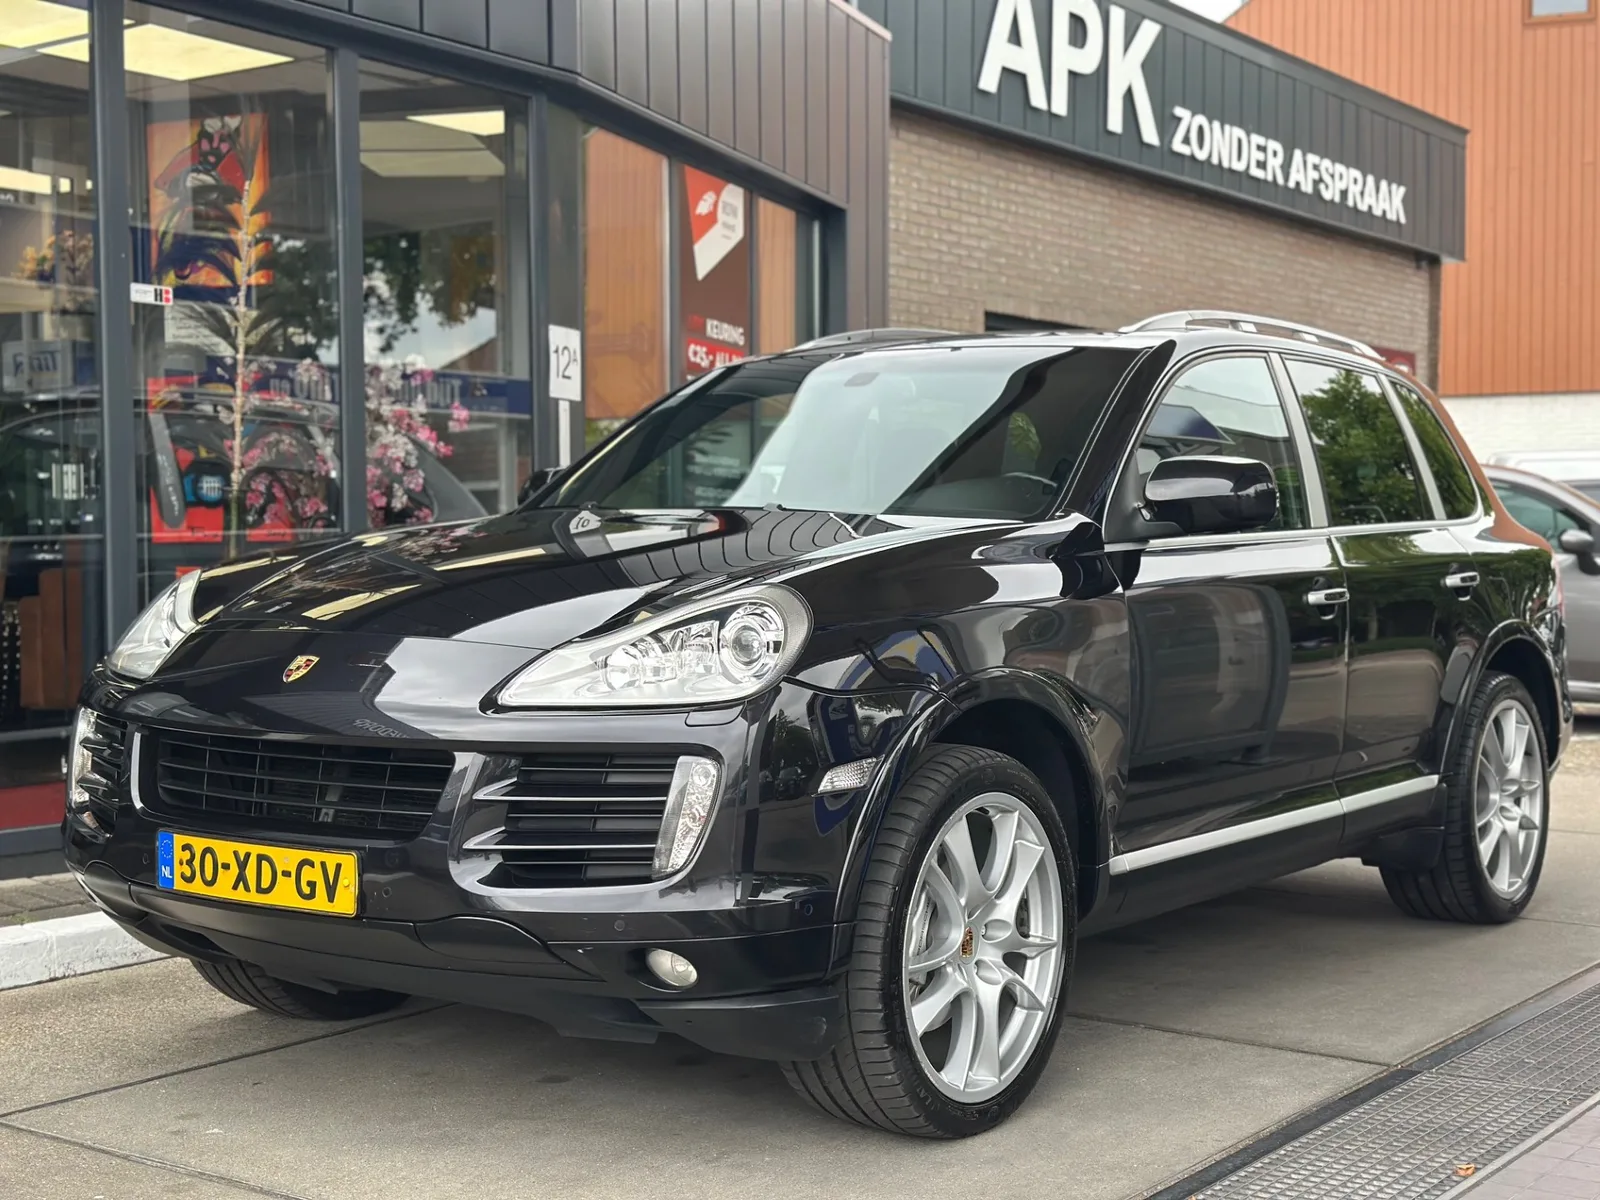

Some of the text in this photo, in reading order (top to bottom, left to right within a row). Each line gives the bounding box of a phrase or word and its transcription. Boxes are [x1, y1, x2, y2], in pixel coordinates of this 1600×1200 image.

[977, 0, 1163, 147] APK
[1171, 105, 1407, 225] ZONDER AFSPRAAK
[705, 317, 746, 347] KEURING
[160, 865, 174, 880] NL
[180, 842, 343, 904] 30-XD-GV
